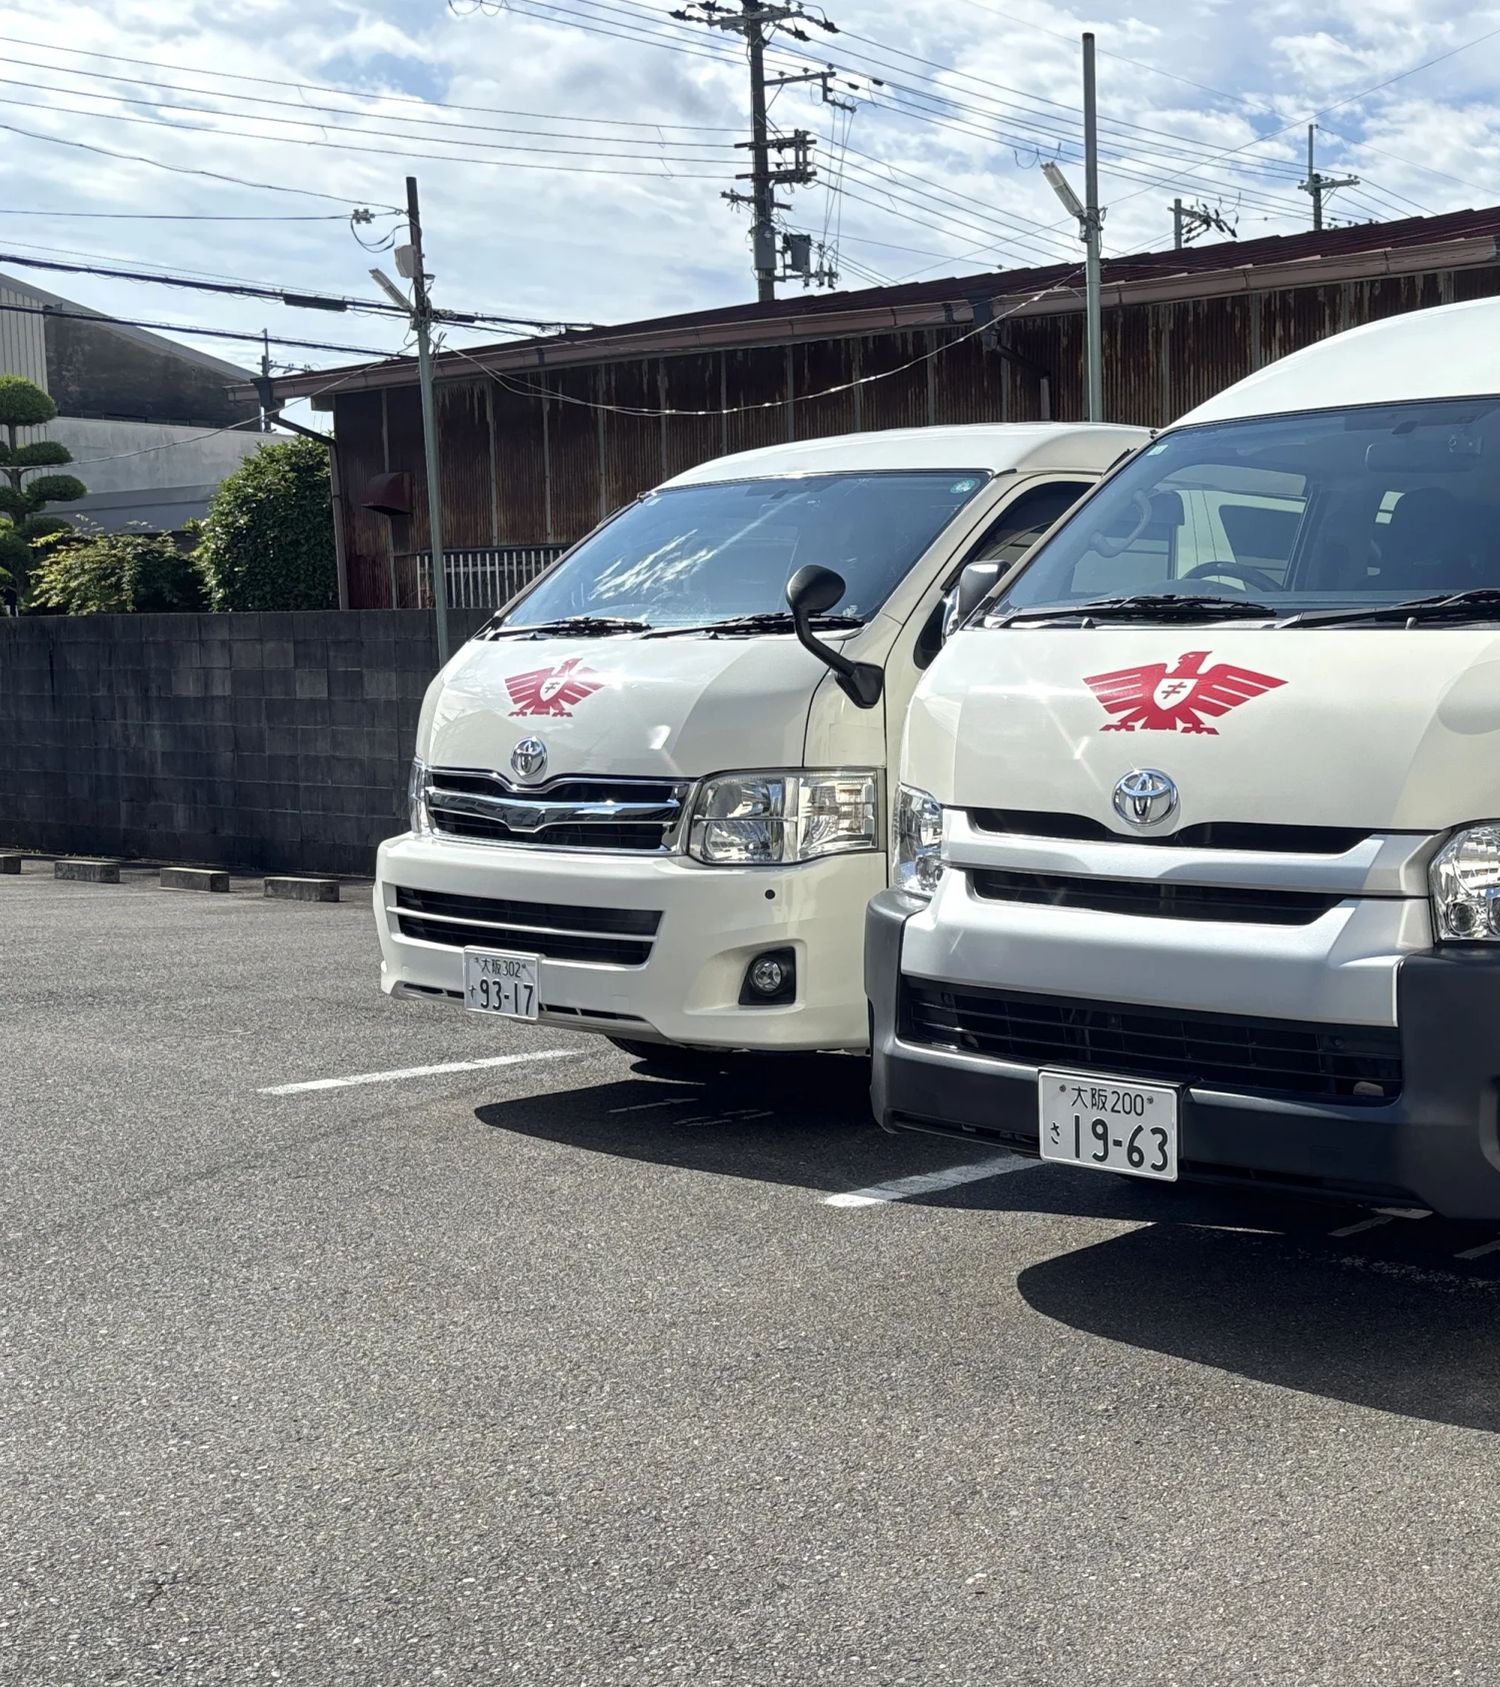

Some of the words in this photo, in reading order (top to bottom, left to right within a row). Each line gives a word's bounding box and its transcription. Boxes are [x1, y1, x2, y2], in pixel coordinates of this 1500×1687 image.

[480, 979, 533, 1015] 93-17
[1071, 1086, 1144, 1116] 大阪200
[1051, 1122, 1061, 1145] さ
[1074, 1115, 1168, 1172] 19-63
